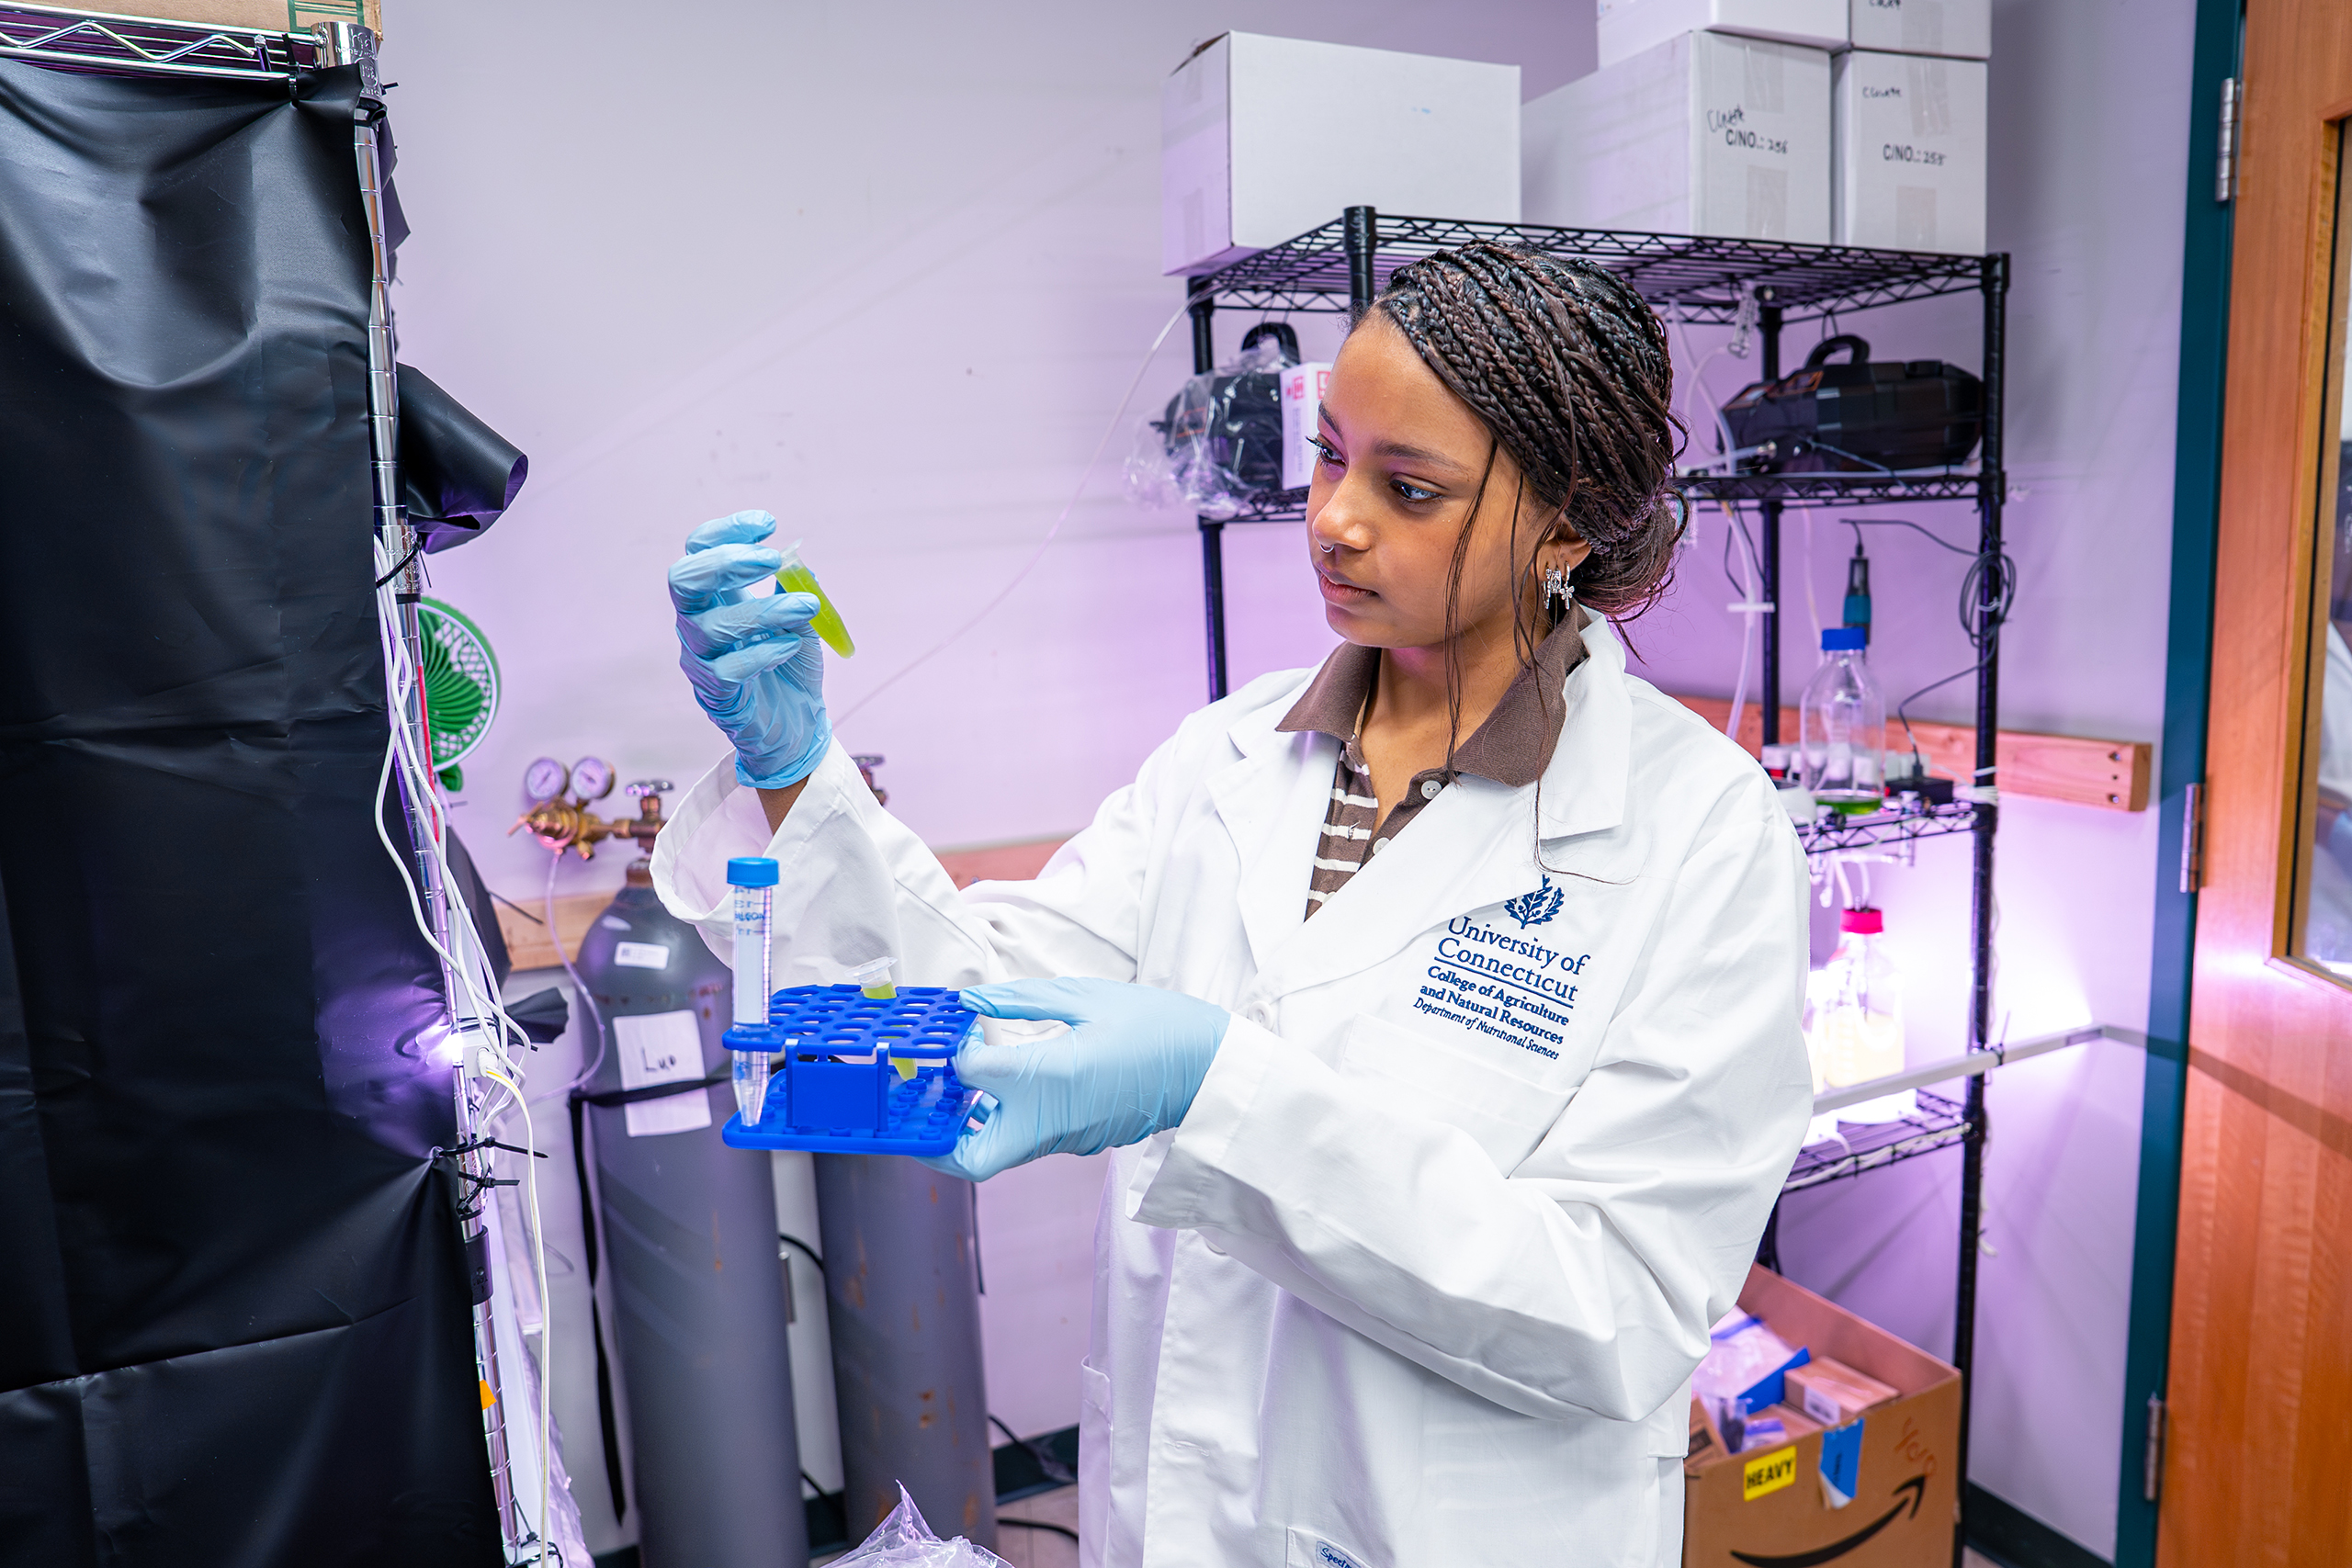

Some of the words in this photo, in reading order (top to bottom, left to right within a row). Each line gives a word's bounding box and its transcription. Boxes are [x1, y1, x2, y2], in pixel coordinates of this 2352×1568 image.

[1438, 937, 1578, 1001] Connecticut
[1447, 916, 1559, 969] University
[1561, 954, 1590, 975] of
[1419, 985, 1446, 1001] and
[1447, 990, 1498, 1020] Natural
[1500, 1010, 1564, 1044] Resources
[1428, 965, 1476, 992] College
[1478, 985, 1496, 997] of
[1493, 988, 1569, 1026] Agriculture
[1413, 997, 1464, 1025] Department
[1464, 1017, 1479, 1030] of
[1476, 1021, 1527, 1048] Nutritional
[1525, 1039, 1560, 1060] Sciences
[1747, 1457, 1794, 1489] HEAVY
